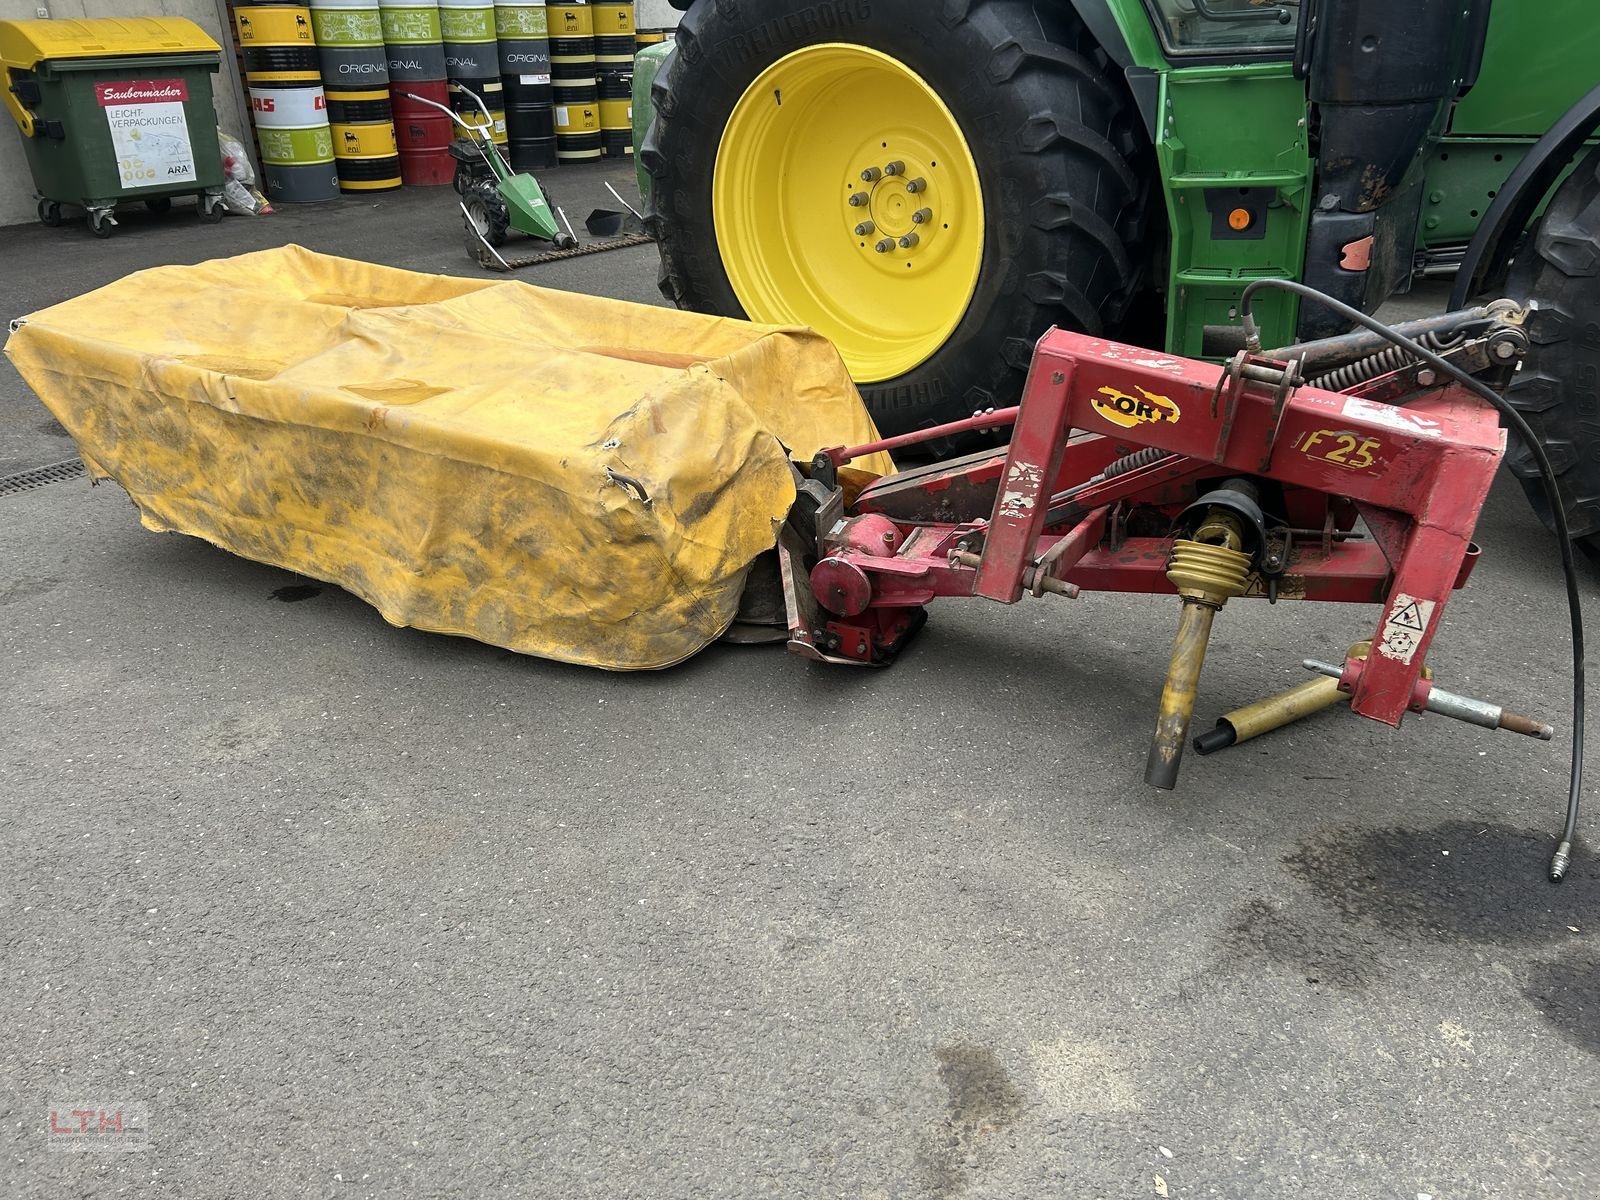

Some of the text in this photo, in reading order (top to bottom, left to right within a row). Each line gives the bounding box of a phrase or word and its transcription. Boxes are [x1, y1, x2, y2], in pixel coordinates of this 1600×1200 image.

[507, 53, 549, 63] ORIGINAL
[338, 62, 386, 74] ORIGINAL
[103, 86, 182, 100] Saubermacher
[111, 109, 143, 118] LEICHT-
[112, 116, 183, 128] VERPACKUNGEN
[1096, 396, 1168, 421] OR
